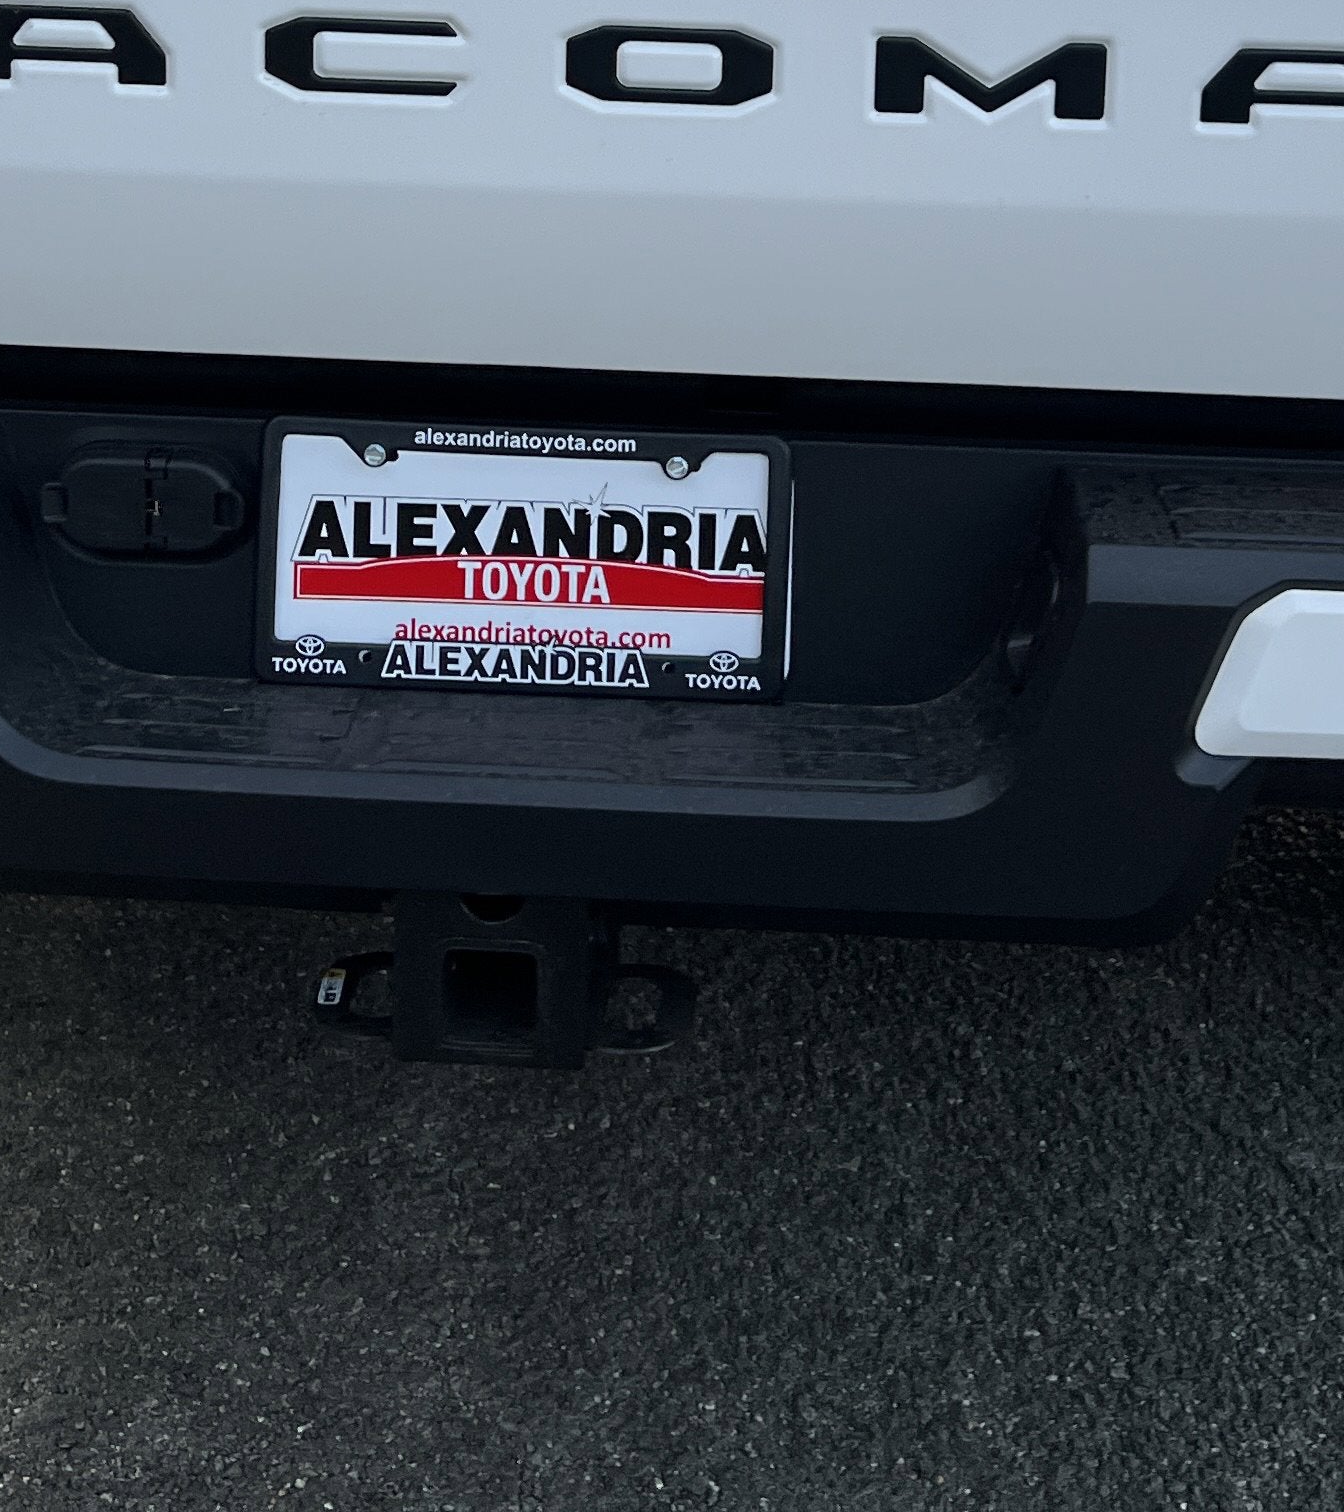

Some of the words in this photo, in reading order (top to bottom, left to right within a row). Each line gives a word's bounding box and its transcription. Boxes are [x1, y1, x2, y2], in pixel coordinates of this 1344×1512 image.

[414, 427, 637, 454] alexandriatoyota.com
[296, 498, 767, 573] ALEXANDRIA
[457, 559, 611, 604] TOYOTA
[394, 617, 672, 649] alexandriatoyota.com
[272, 656, 347, 675] TOYOTA
[381, 640, 649, 688] ALEXANDRIA
[685, 673, 761, 691] TOYOTA
